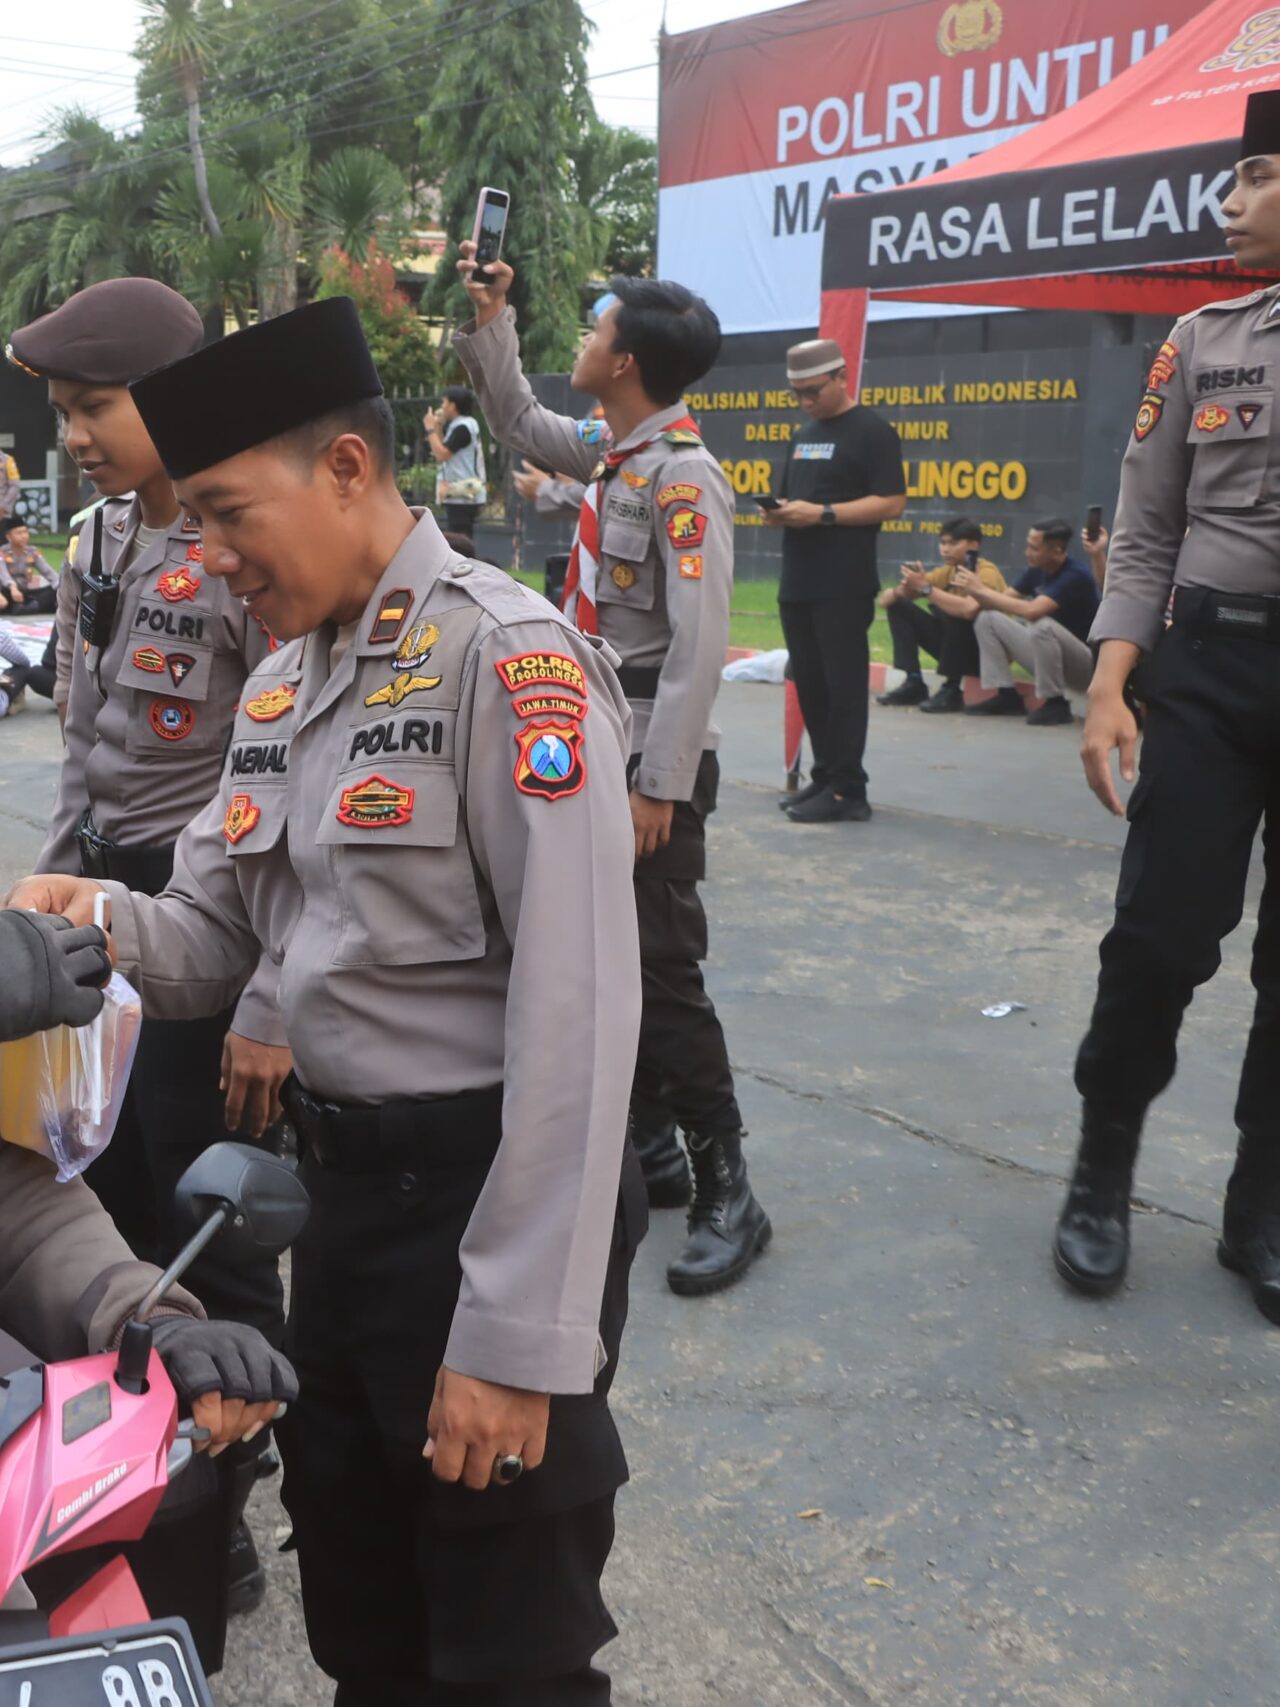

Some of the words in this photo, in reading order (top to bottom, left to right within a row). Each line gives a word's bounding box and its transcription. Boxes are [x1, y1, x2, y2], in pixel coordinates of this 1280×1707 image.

[777, 76, 940, 162] POLRI
[869, 203, 1012, 266] RASA
[954, 379, 1077, 402] INDONESIA
[1196, 366, 1264, 392] RISKI
[745, 424, 801, 441] DAER
[135, 607, 203, 639] POLRI
[505, 655, 582, 679] POLRES
[509, 667, 583, 689] PROBOLINGGO
[521, 700, 548, 712] JAWA
[551, 699, 579, 714] TIMUR
[350, 718, 443, 761] POLRI
[56, 1485, 93, 1524] Combi
[95, 1461, 127, 1494] Brake
